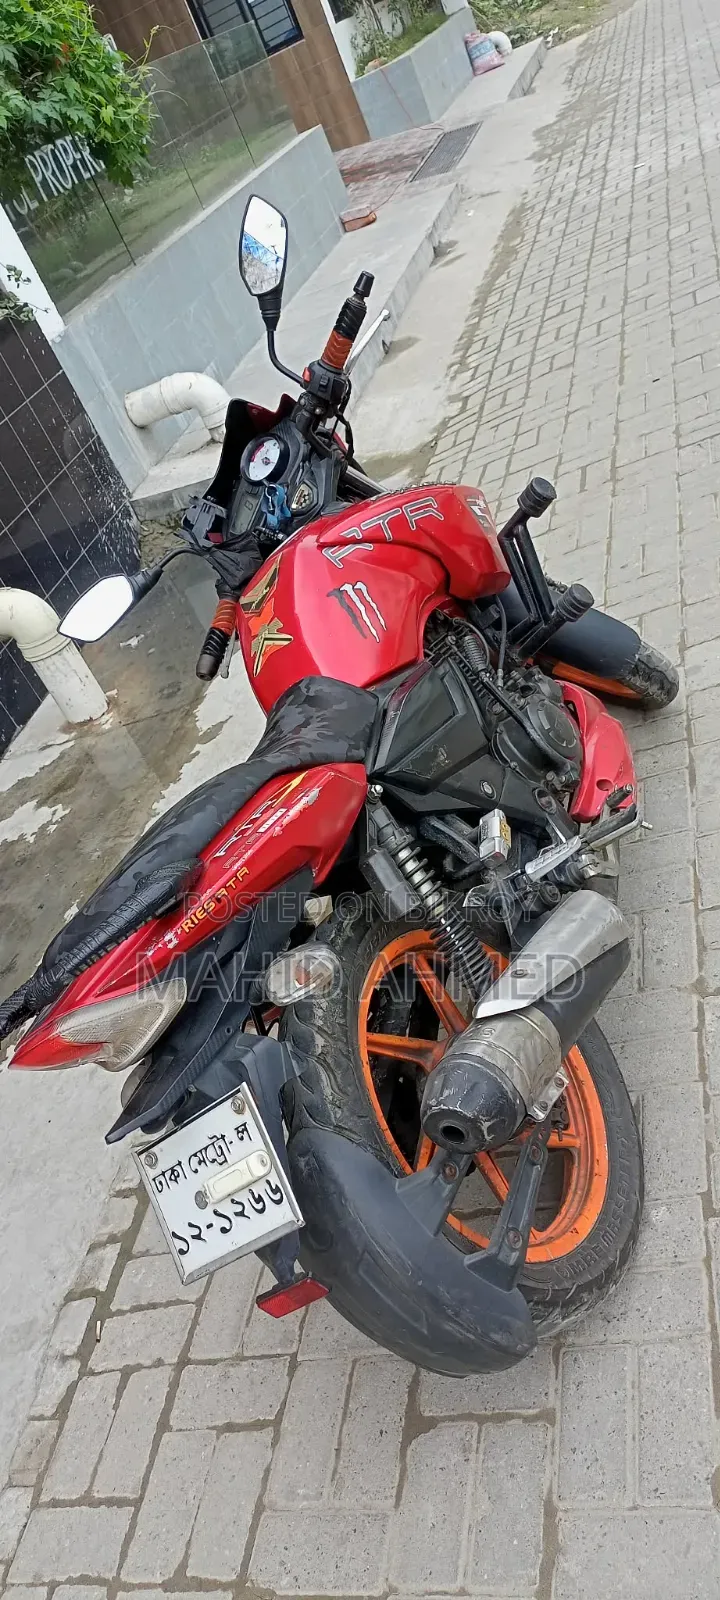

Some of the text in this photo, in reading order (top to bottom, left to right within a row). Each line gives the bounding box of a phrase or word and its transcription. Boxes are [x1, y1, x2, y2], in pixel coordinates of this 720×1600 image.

[322, 497, 444, 568] RTR
[152, 1160, 188, 1193] ঢাকা
[172, 1179, 284, 1256] ১২-১২৬৬
